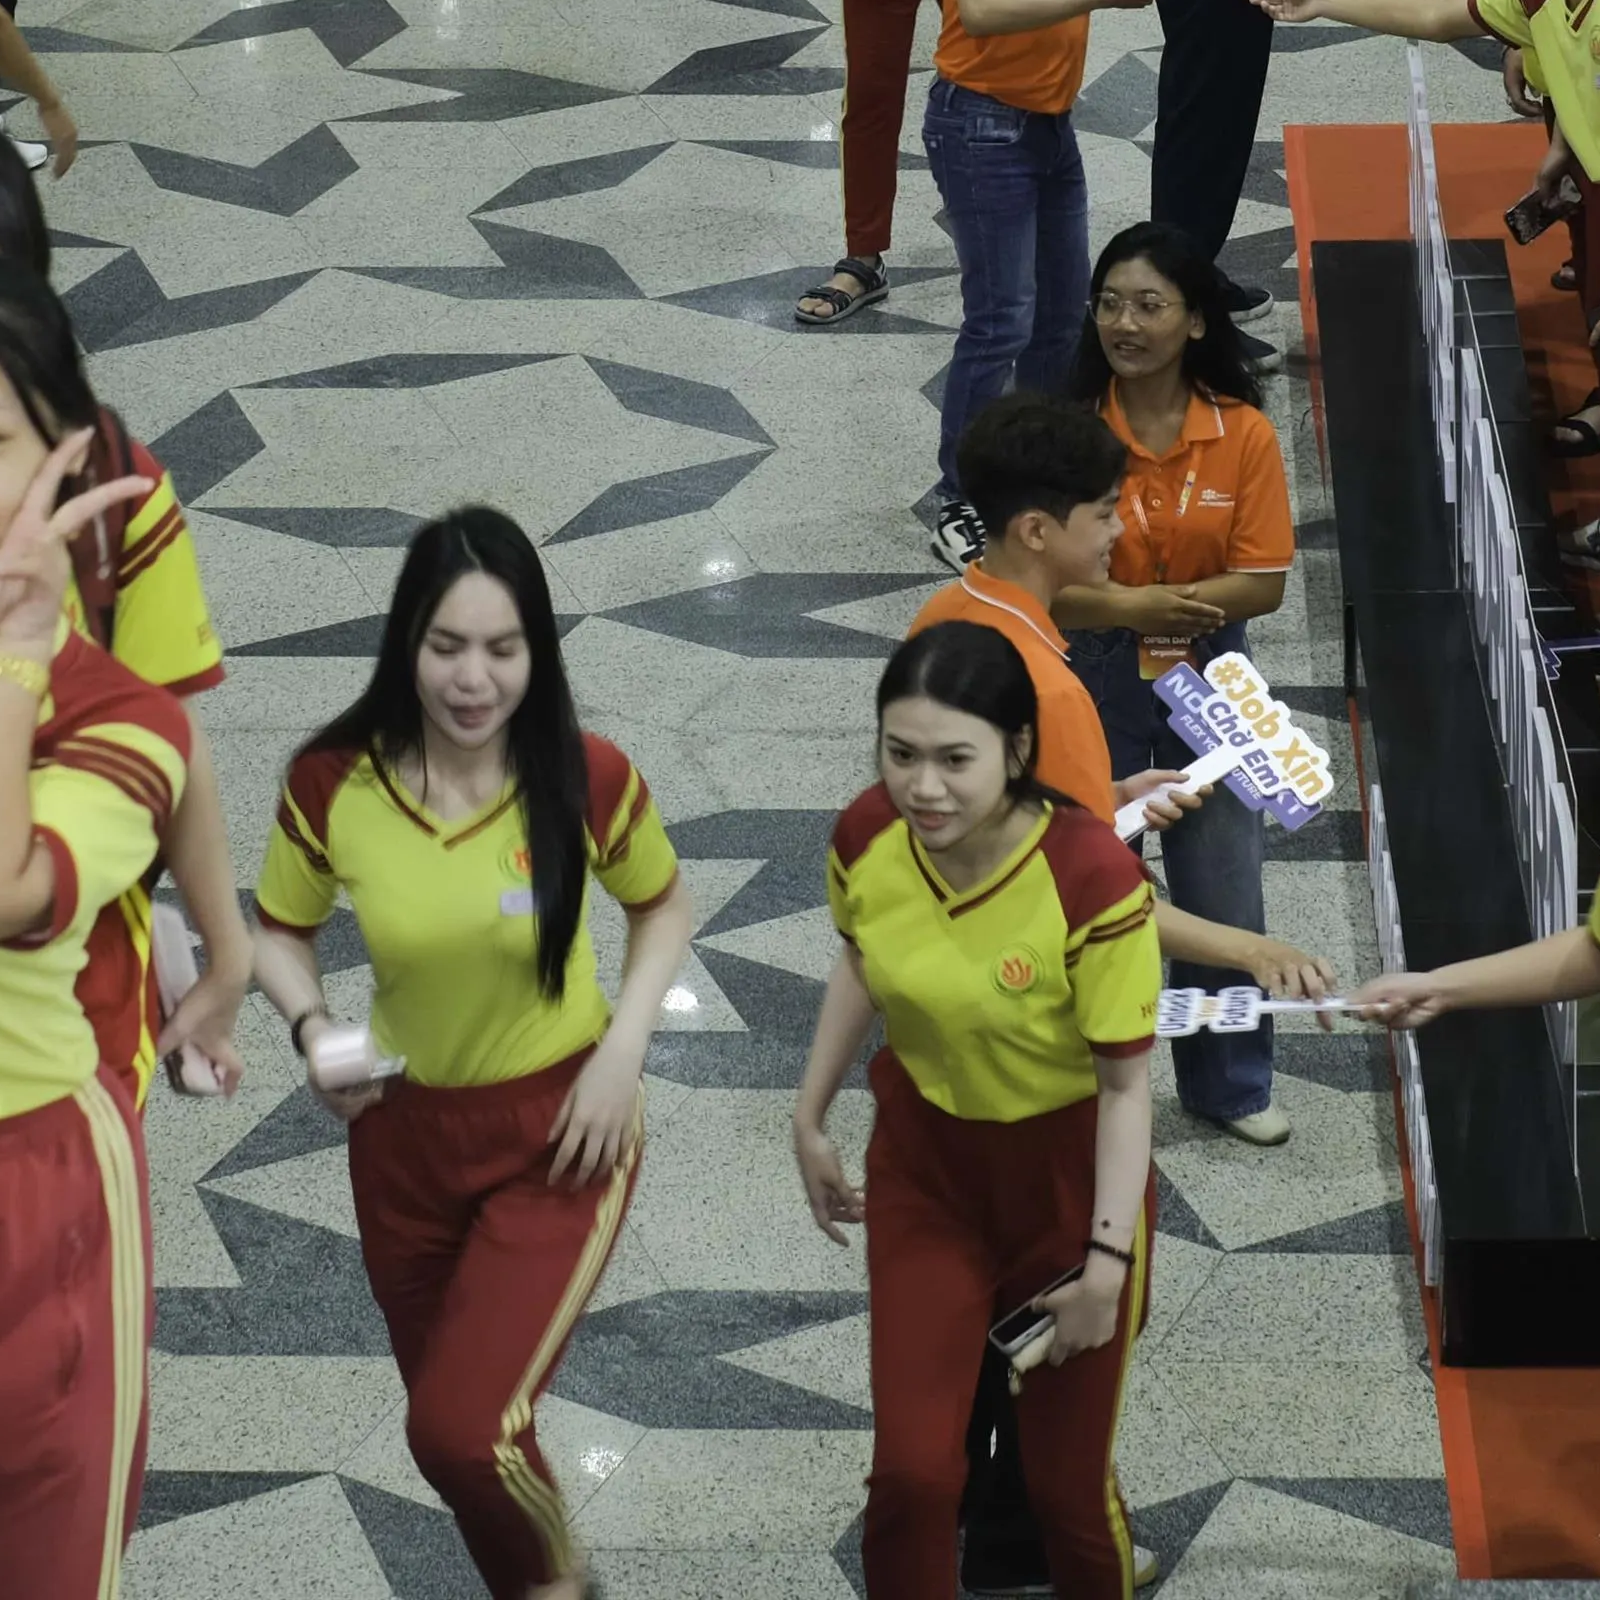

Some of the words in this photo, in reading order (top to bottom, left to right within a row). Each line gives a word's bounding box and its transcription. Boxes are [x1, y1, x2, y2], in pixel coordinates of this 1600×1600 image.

[1143, 635, 1171, 645] OPEN
[1172, 635, 1192, 645] DAY
[1213, 660, 1280, 739] #Job
[1180, 714, 1206, 740] FLEX
[1207, 701, 1254, 748] Chờ
[1241, 748, 1280, 790] Em
